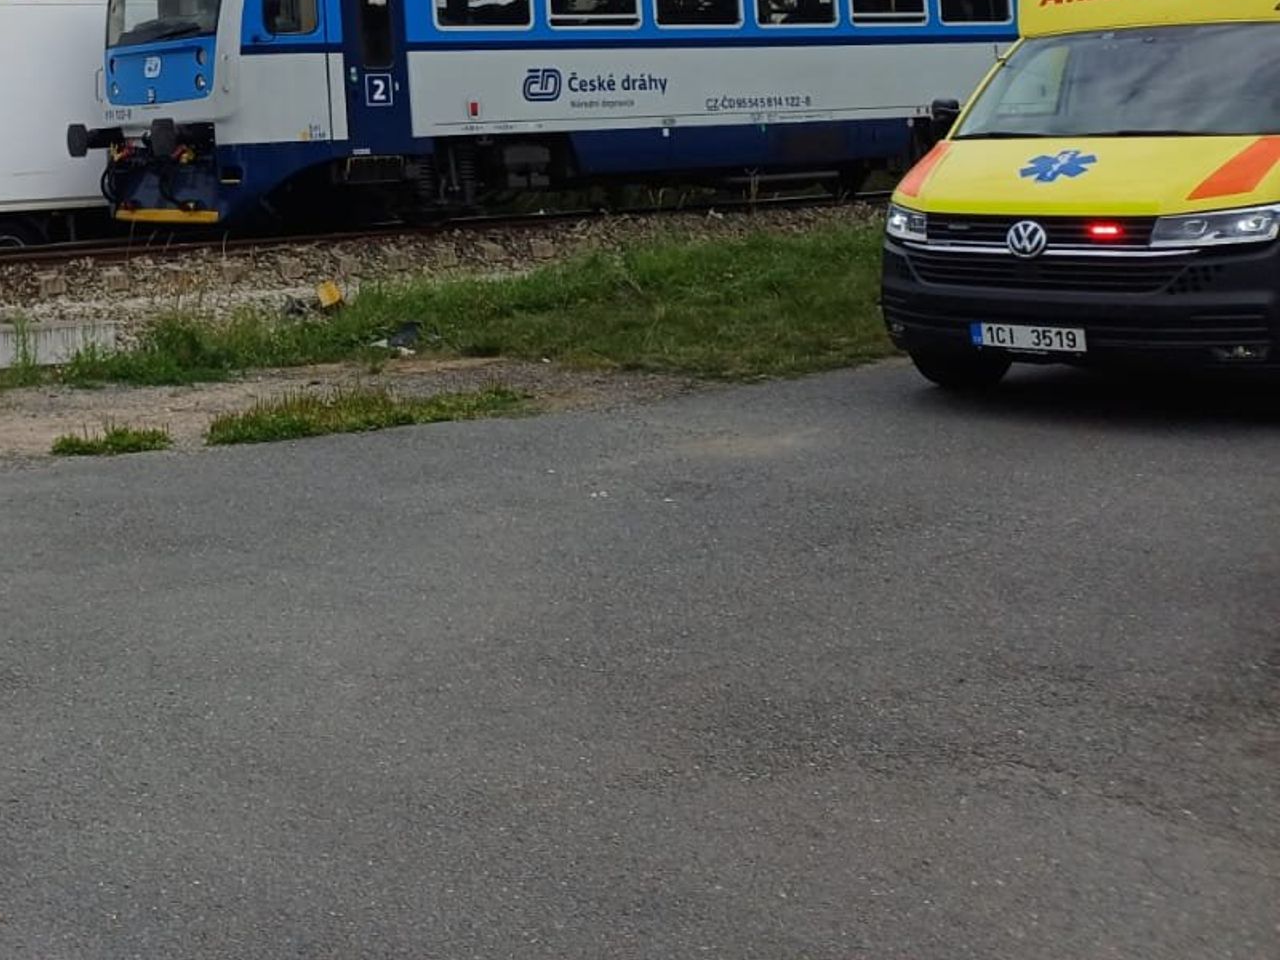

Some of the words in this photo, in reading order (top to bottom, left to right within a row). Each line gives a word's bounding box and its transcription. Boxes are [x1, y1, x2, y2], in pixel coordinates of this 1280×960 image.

[372, 79, 387, 100] 2
[568, 72, 616, 92] České
[621, 73, 668, 96] dráhy
[987, 326, 1014, 345] 1CI
[1031, 329, 1077, 348] 3519
